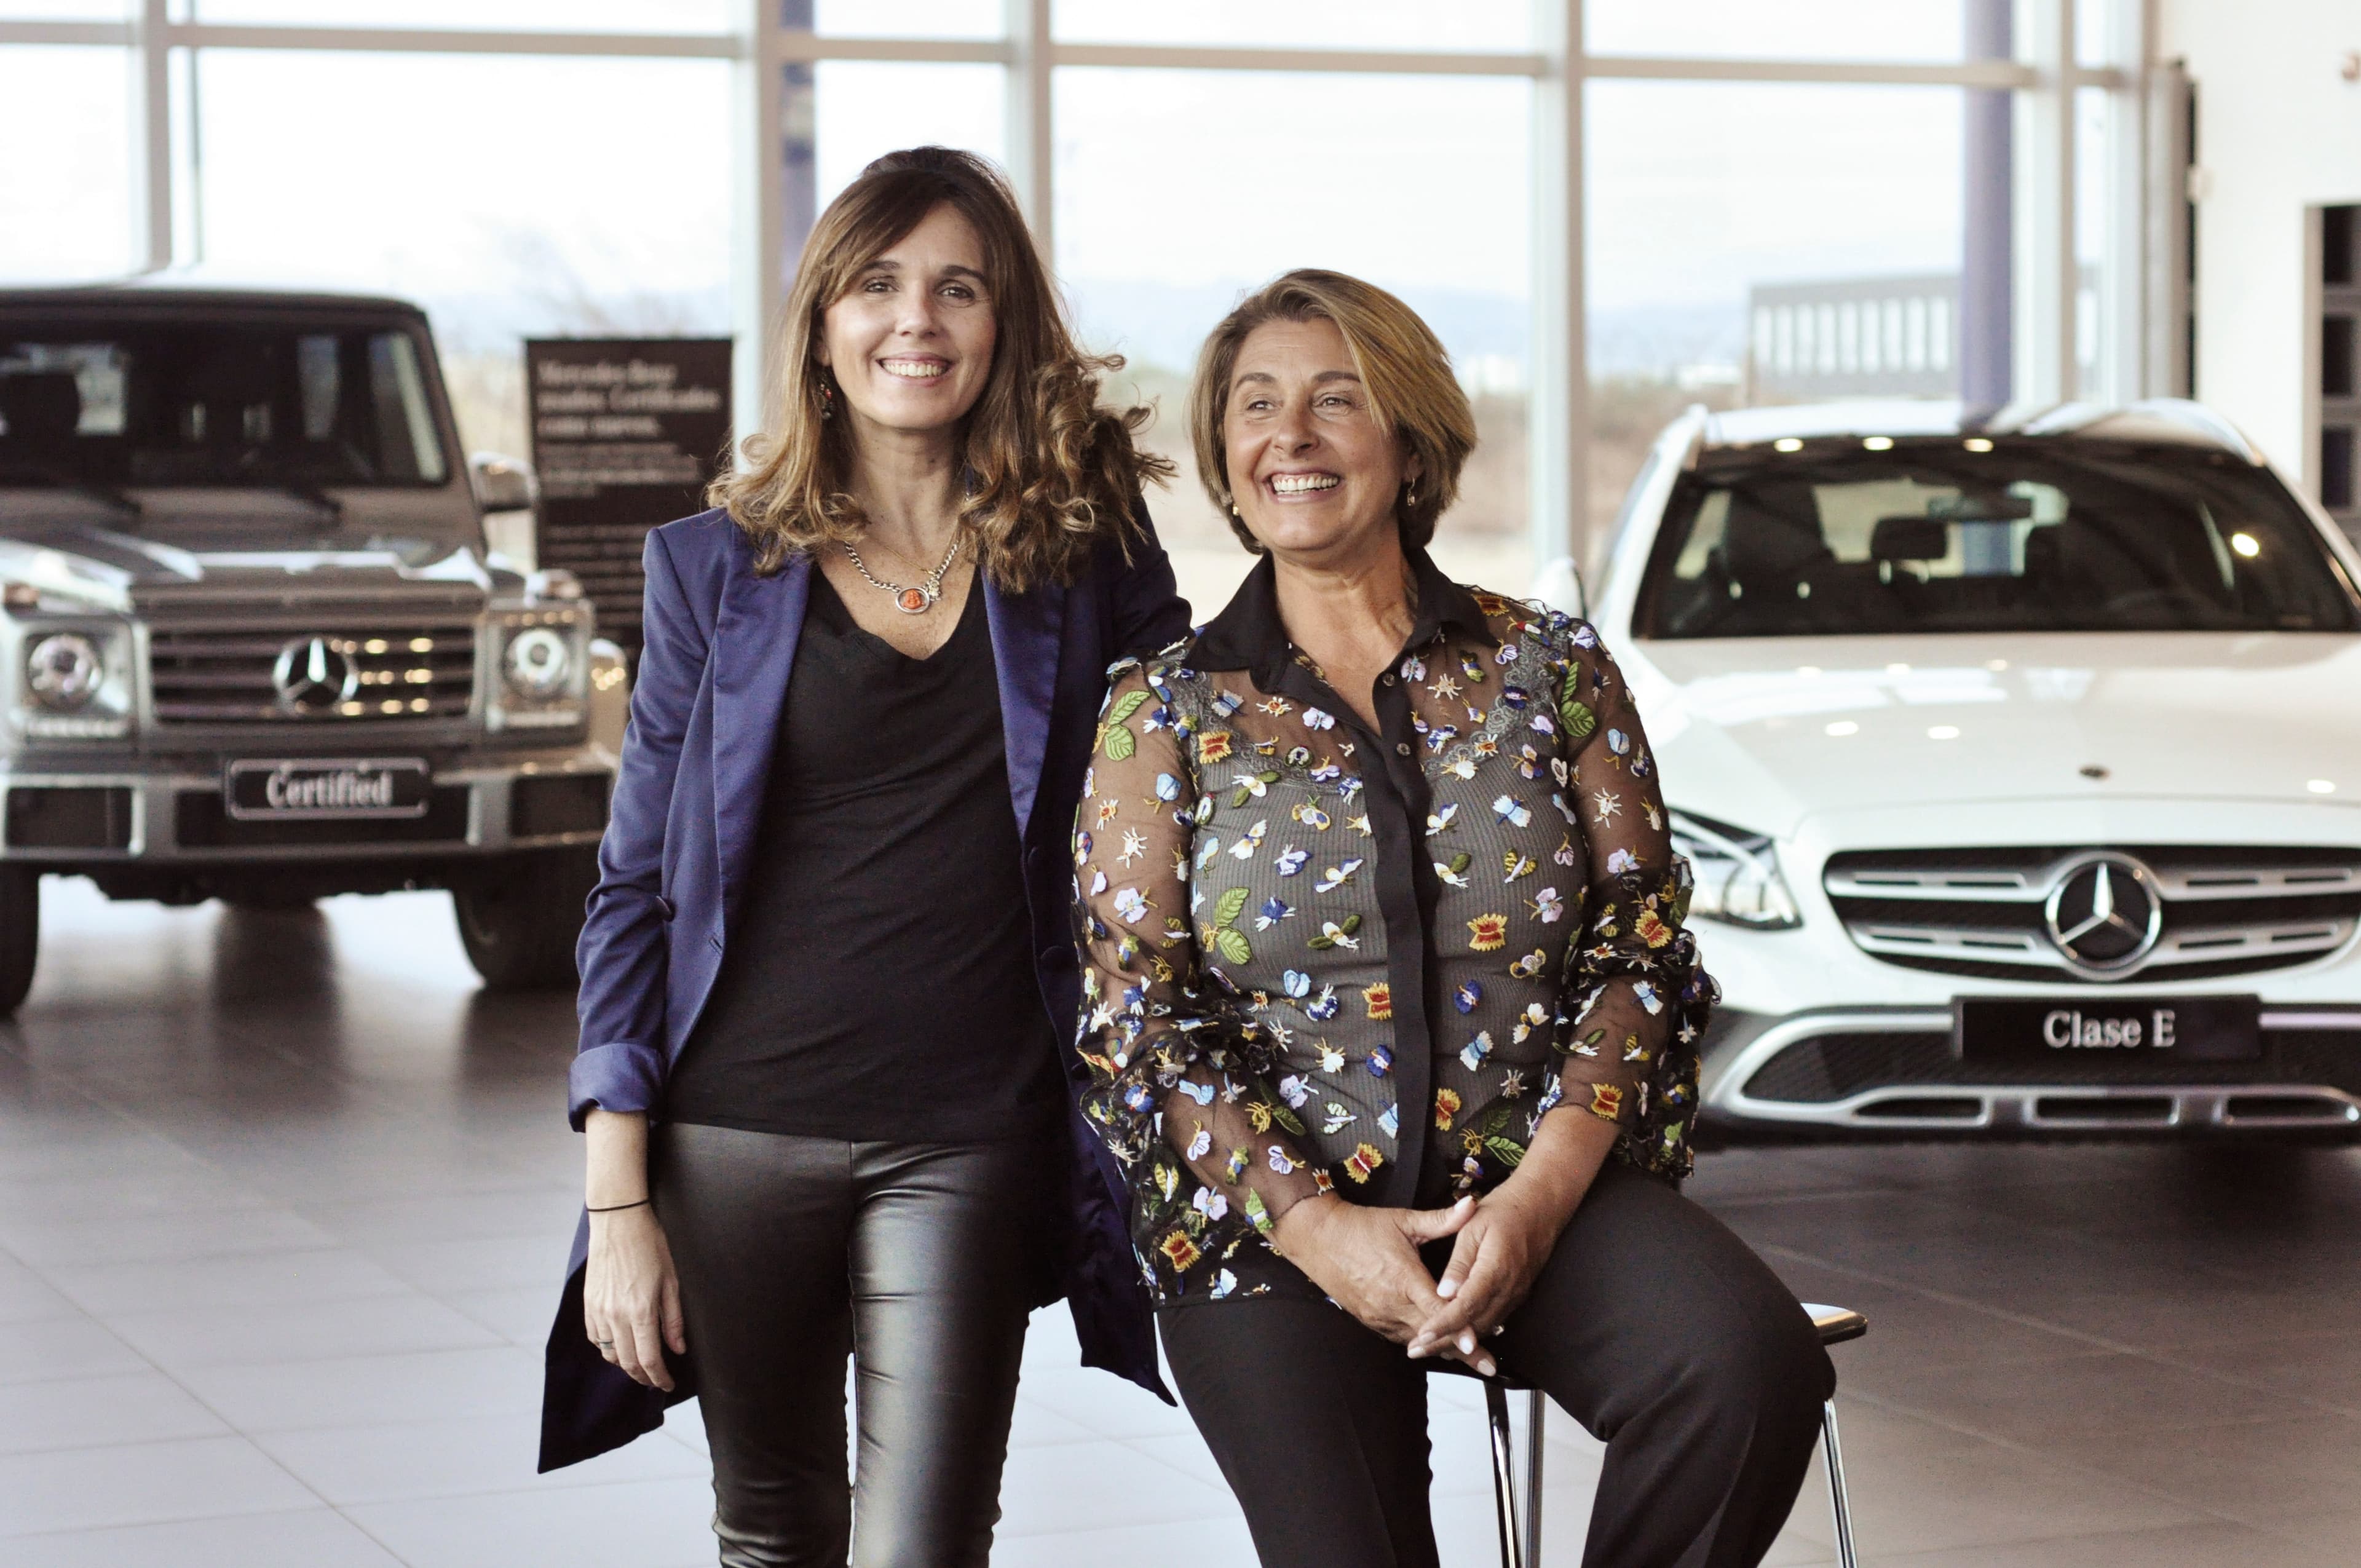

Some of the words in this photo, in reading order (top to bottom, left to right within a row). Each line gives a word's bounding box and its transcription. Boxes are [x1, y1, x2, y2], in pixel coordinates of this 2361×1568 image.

[266, 770, 393, 807] Certified
[2043, 1010, 2142, 1048] Clase
[2153, 1010, 2176, 1048] E
